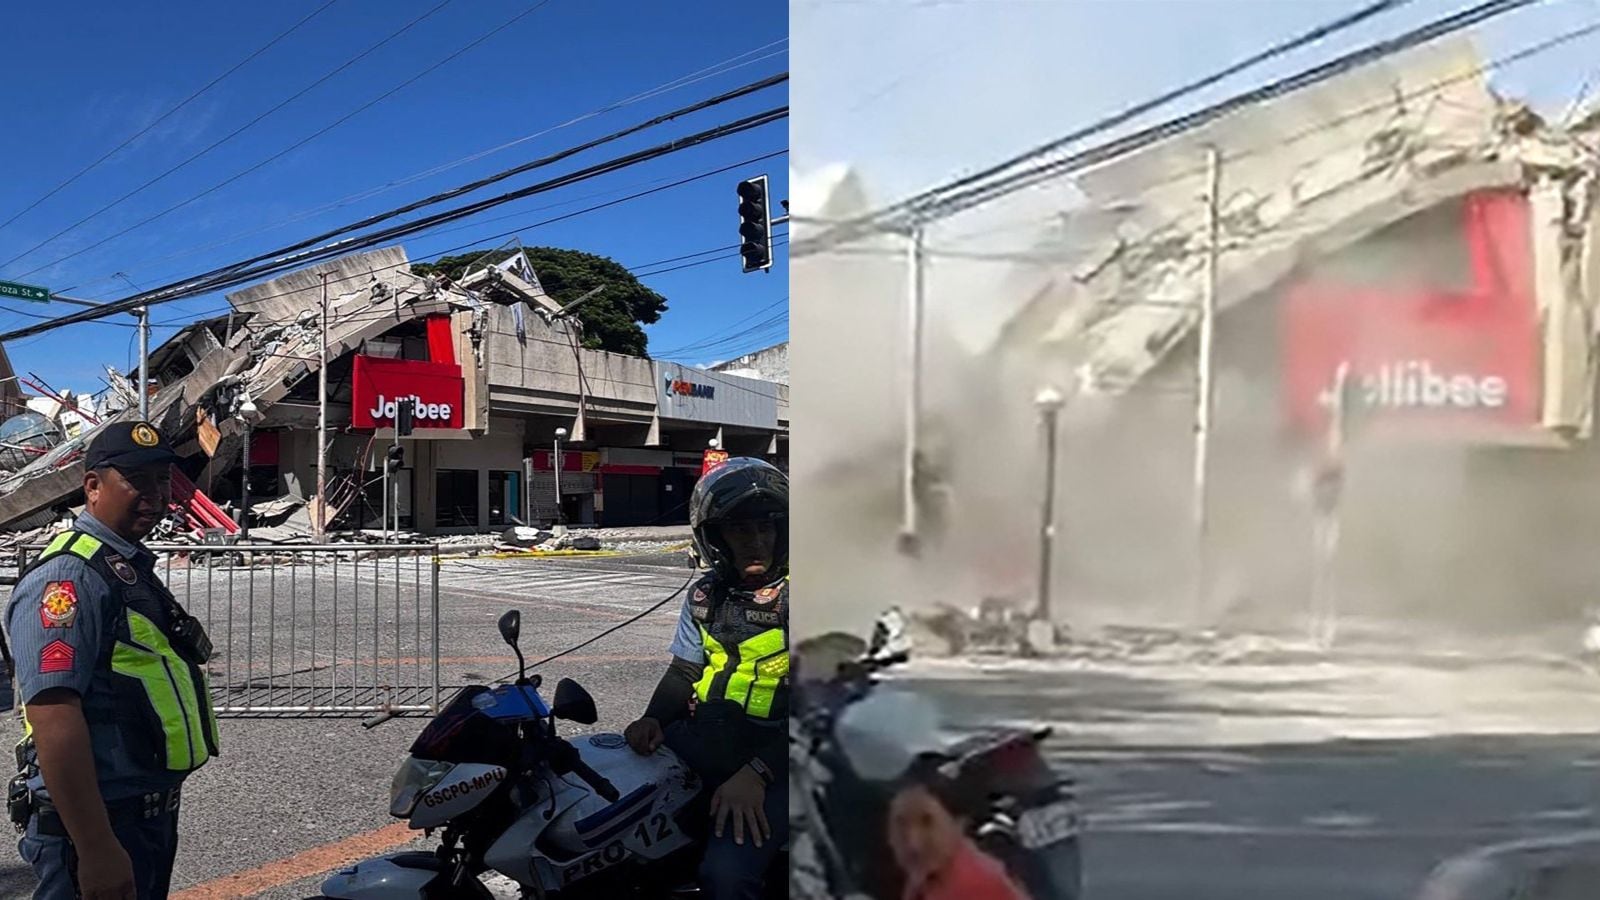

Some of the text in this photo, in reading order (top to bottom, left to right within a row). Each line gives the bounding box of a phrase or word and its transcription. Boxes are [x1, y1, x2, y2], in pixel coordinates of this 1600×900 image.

[21, 288, 33, 297] St.
[746, 610, 777, 622] POLICE
[423, 767, 504, 808] GSCPO-MPU
[563, 812, 673, 882] PRO 12
